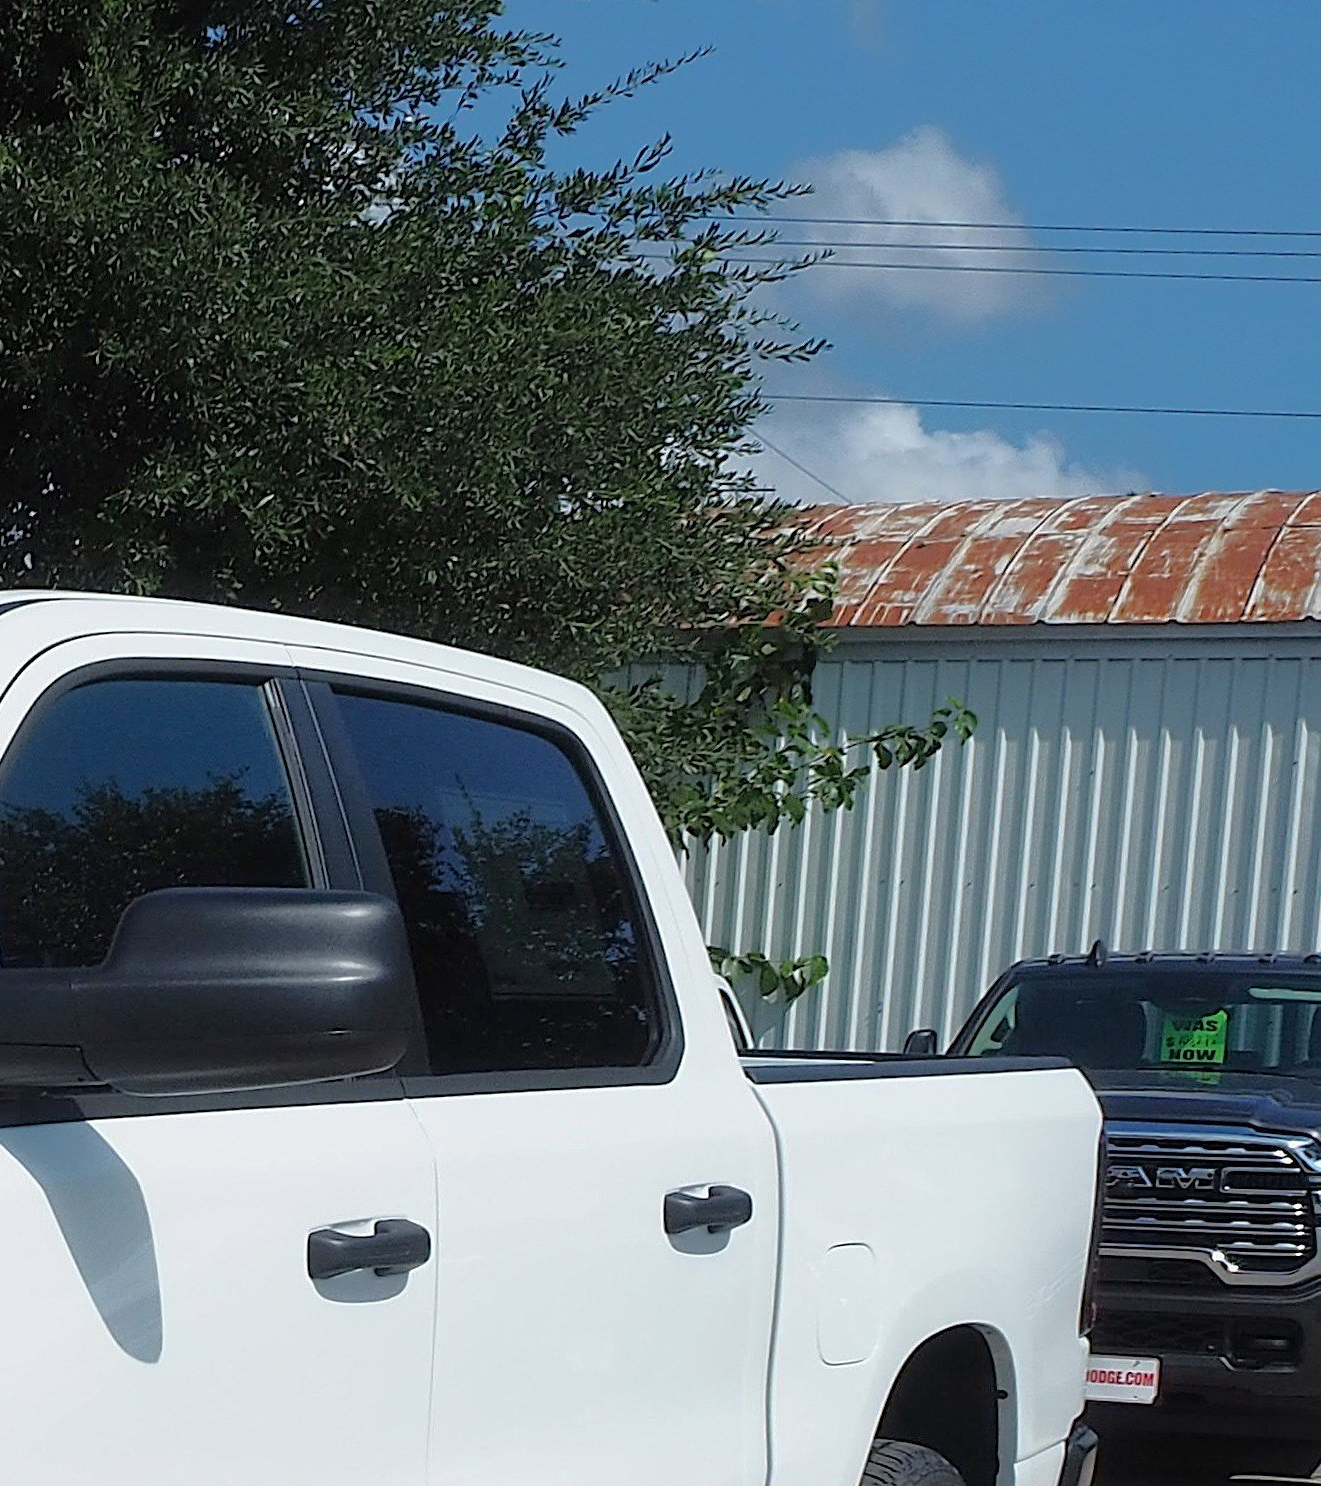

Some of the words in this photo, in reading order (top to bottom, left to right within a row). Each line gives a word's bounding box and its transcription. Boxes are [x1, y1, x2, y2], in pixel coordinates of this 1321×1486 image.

[1172, 1020, 1219, 1032] WAS
[1169, 1049, 1217, 1061] NOW
[1105, 1165, 1215, 1189] AM
